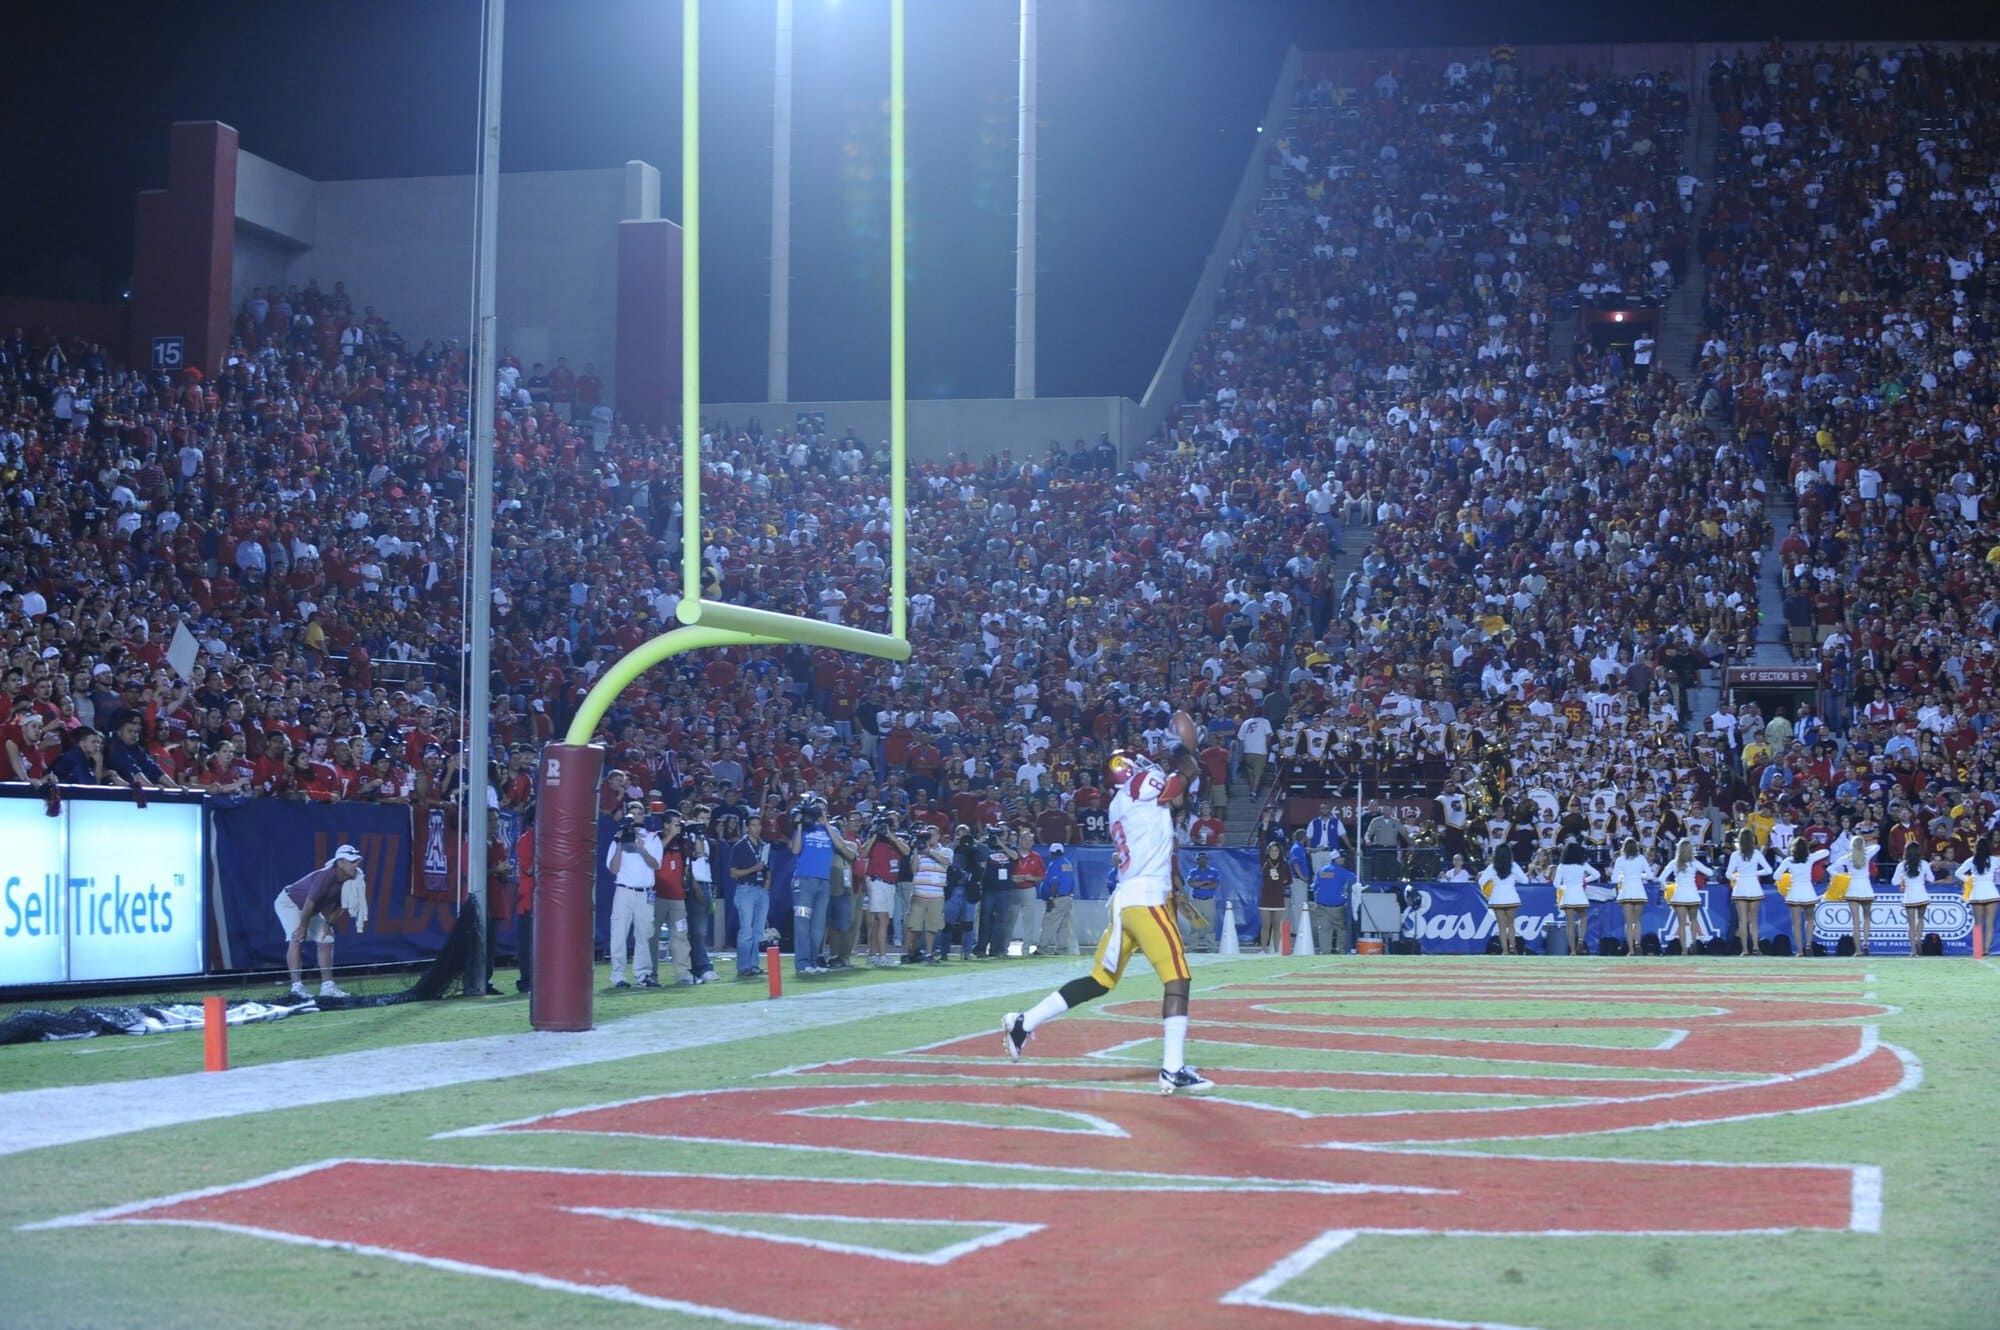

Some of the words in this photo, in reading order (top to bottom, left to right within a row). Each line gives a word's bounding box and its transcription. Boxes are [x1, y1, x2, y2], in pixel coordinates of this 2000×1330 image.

[154, 342, 181, 365] 15
[1758, 671, 1790, 681] SECTION
[1594, 702, 1611, 719] 10
[1341, 806, 1353, 819] 16
[1085, 815, 1105, 831] 94
[4, 873, 60, 937] Sell
[1869, 908, 1957, 925] CASNOS
